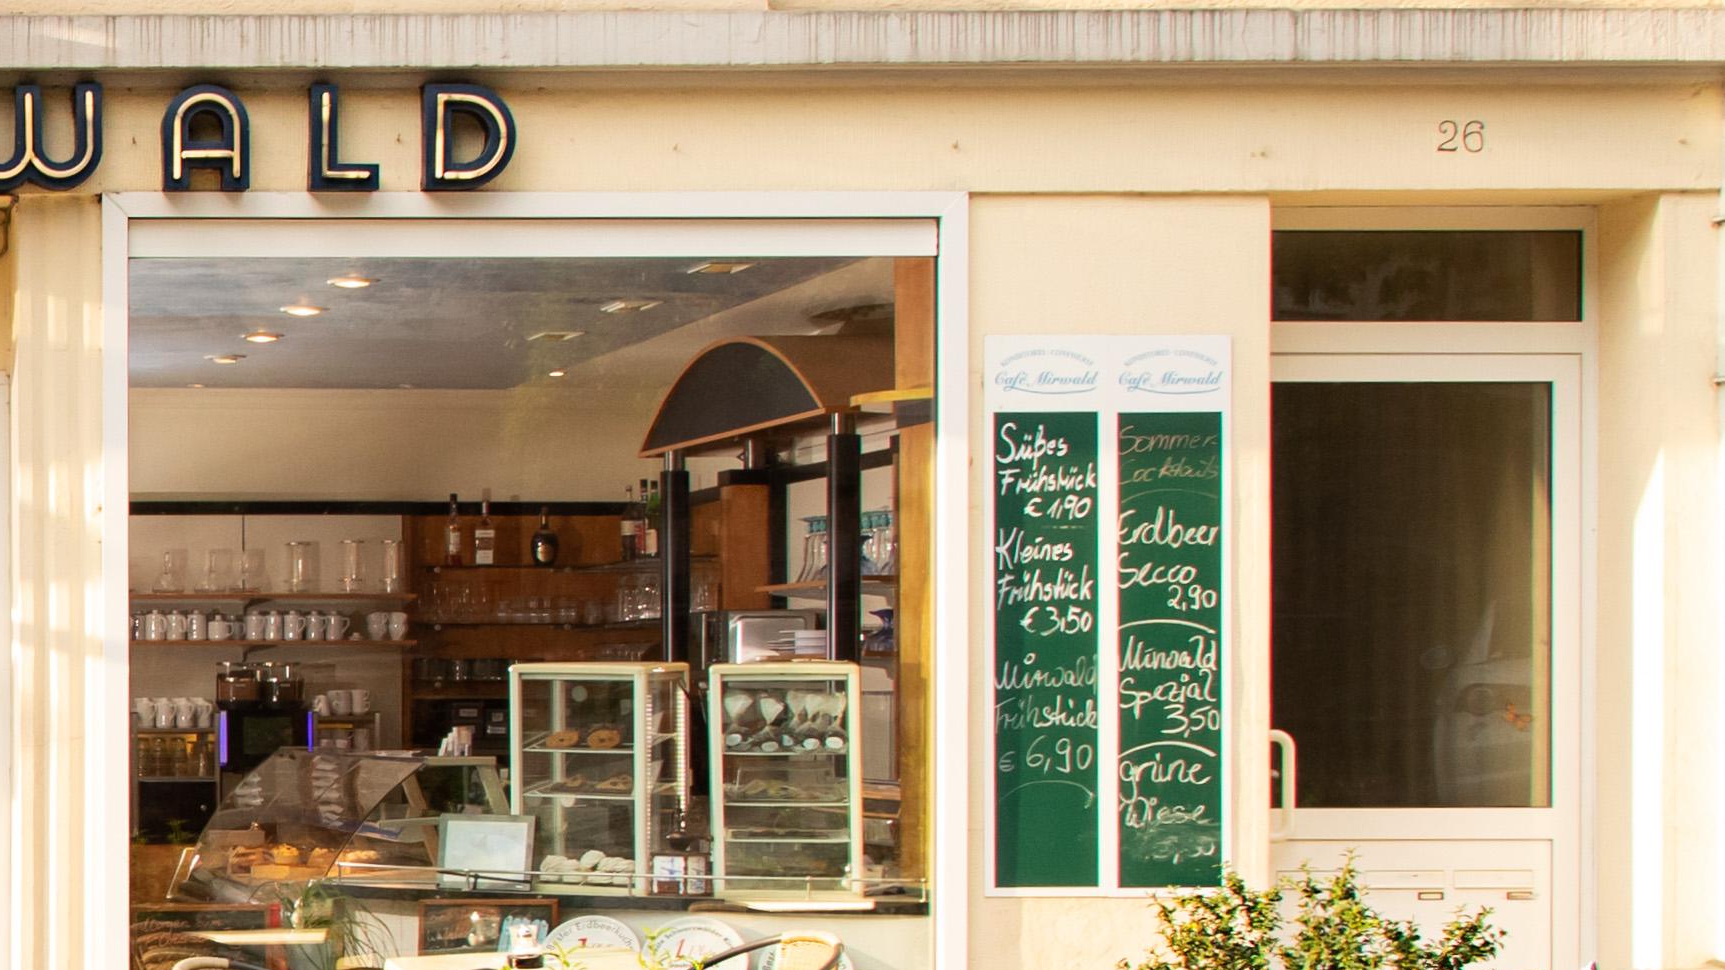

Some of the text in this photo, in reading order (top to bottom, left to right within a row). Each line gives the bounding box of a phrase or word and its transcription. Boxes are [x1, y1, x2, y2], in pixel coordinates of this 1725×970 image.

[1437, 119, 1484, 153] 26
[995, 371, 1099, 391] Café Mirwald
[1118, 371, 1223, 391] Café Mirwald
[997, 462, 1097, 496] Frühstück
[1117, 505, 1219, 548] Erdbeer
[995, 527, 1074, 571] Kleines
[997, 564, 1094, 611] Frühstück
[1117, 552, 1198, 590] Secco
[1167, 584, 1218, 612] 2,90
[1119, 668, 1218, 719] Spezial
[994, 695, 1098, 735] Frühstück
[1160, 703, 1220, 739] 3,50
[1026, 734, 1093, 774] 6,90
